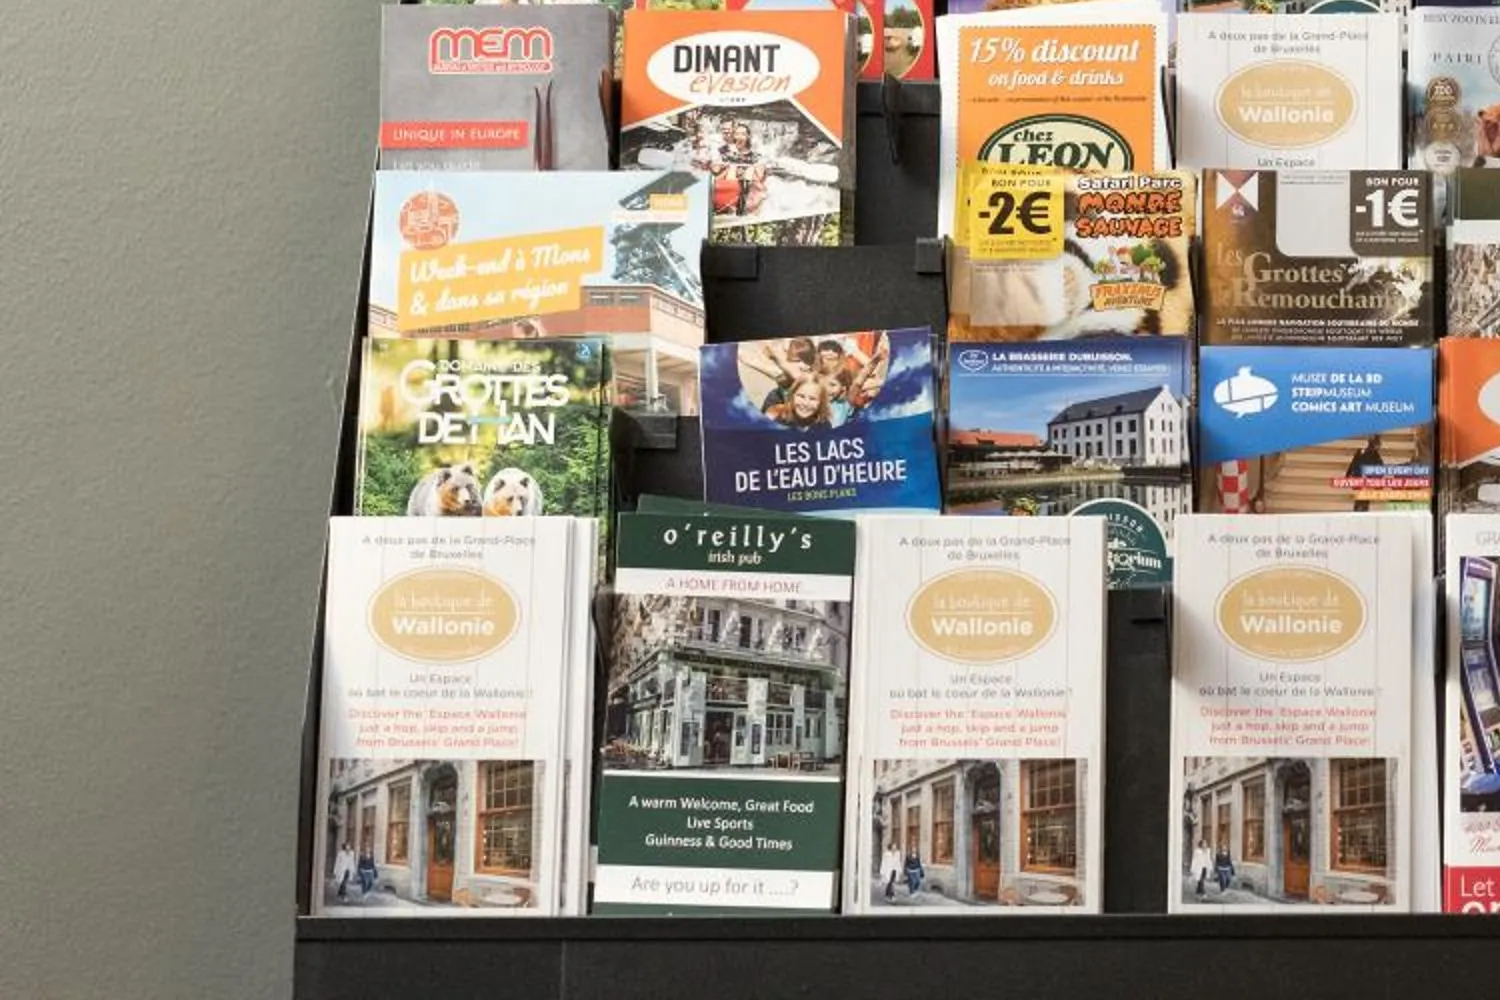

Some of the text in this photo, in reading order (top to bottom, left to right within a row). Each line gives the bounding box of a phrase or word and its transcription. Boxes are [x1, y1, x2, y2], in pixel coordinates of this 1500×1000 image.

[674, 44, 781, 74] DINANT
[970, 36, 1140, 65] 15% discount
[987, 67, 1125, 91] on food & drinks
[393, 127, 521, 142] UNIQUE IN EUROPE
[1013, 129, 1055, 145] chez
[991, 178, 1051, 188] BON POUR
[1077, 176, 1182, 190] Safari Parc
[979, 191, 1051, 236] -2€
[1355, 188, 1419, 228] -1€
[1075, 216, 1182, 238] SAUVAGE
[410, 243, 591, 283] Week-end à Mons
[992, 353, 1006, 361] LA
[1009, 352, 1066, 362] BRASSERIE
[1291, 400, 1414, 413] COMICS ART MUSEUM
[932, 618, 1033, 637] Wallonie
[1242, 616, 1342, 635] Wallonie
[629, 795, 814, 813] A warm Welcome, Great Food
[687, 816, 753, 832] Live Sports
[645, 834, 793, 851] Guinness & Good Times
[1460, 878, 1493, 898] Let
